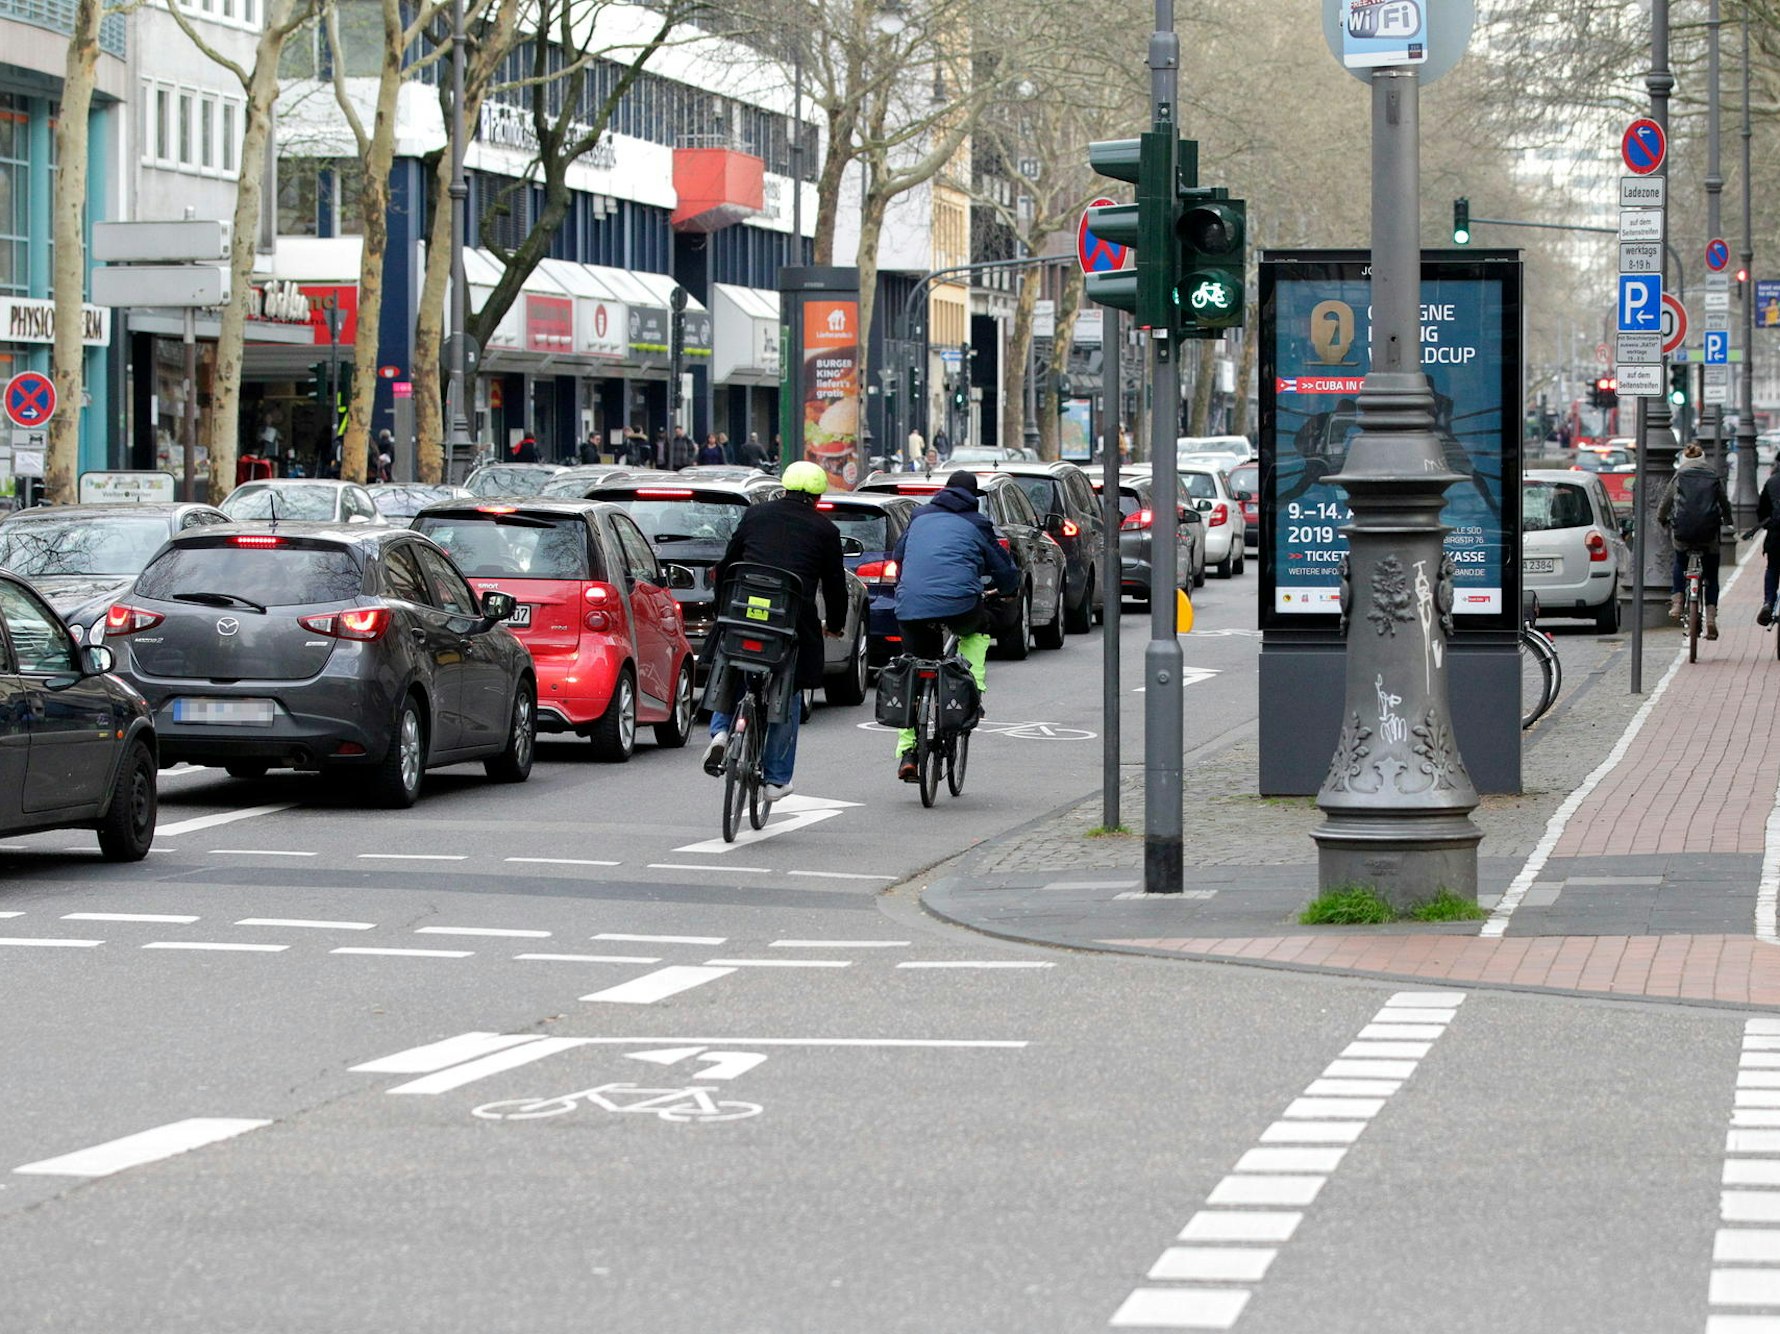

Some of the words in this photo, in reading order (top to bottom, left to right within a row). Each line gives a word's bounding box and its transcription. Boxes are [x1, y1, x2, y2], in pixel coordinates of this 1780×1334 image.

[1624, 187, 1659, 198] Ladezone
[1622, 229, 1659, 237] Seitenstreifen
[1625, 246, 1657, 258] werktags
[1628, 260, 1644, 270] 8-19
[1624, 281, 1649, 324] P
[816, 359, 852, 368] BURGER
[1638, 371, 1651, 379] dem
[1315, 381, 1344, 391] CUBA
[1346, 381, 1357, 391] IN
[1619, 381, 1659, 390] Seitenstreifen
[816, 389, 844, 399] gratis
[1287, 526, 1334, 543] 2019
[1466, 525, 1483, 534] SÜD
[1304, 550, 1350, 562] TICKET
[1529, 560, 1552, 570] 2384
[1288, 567, 1321, 576] WEITERE
